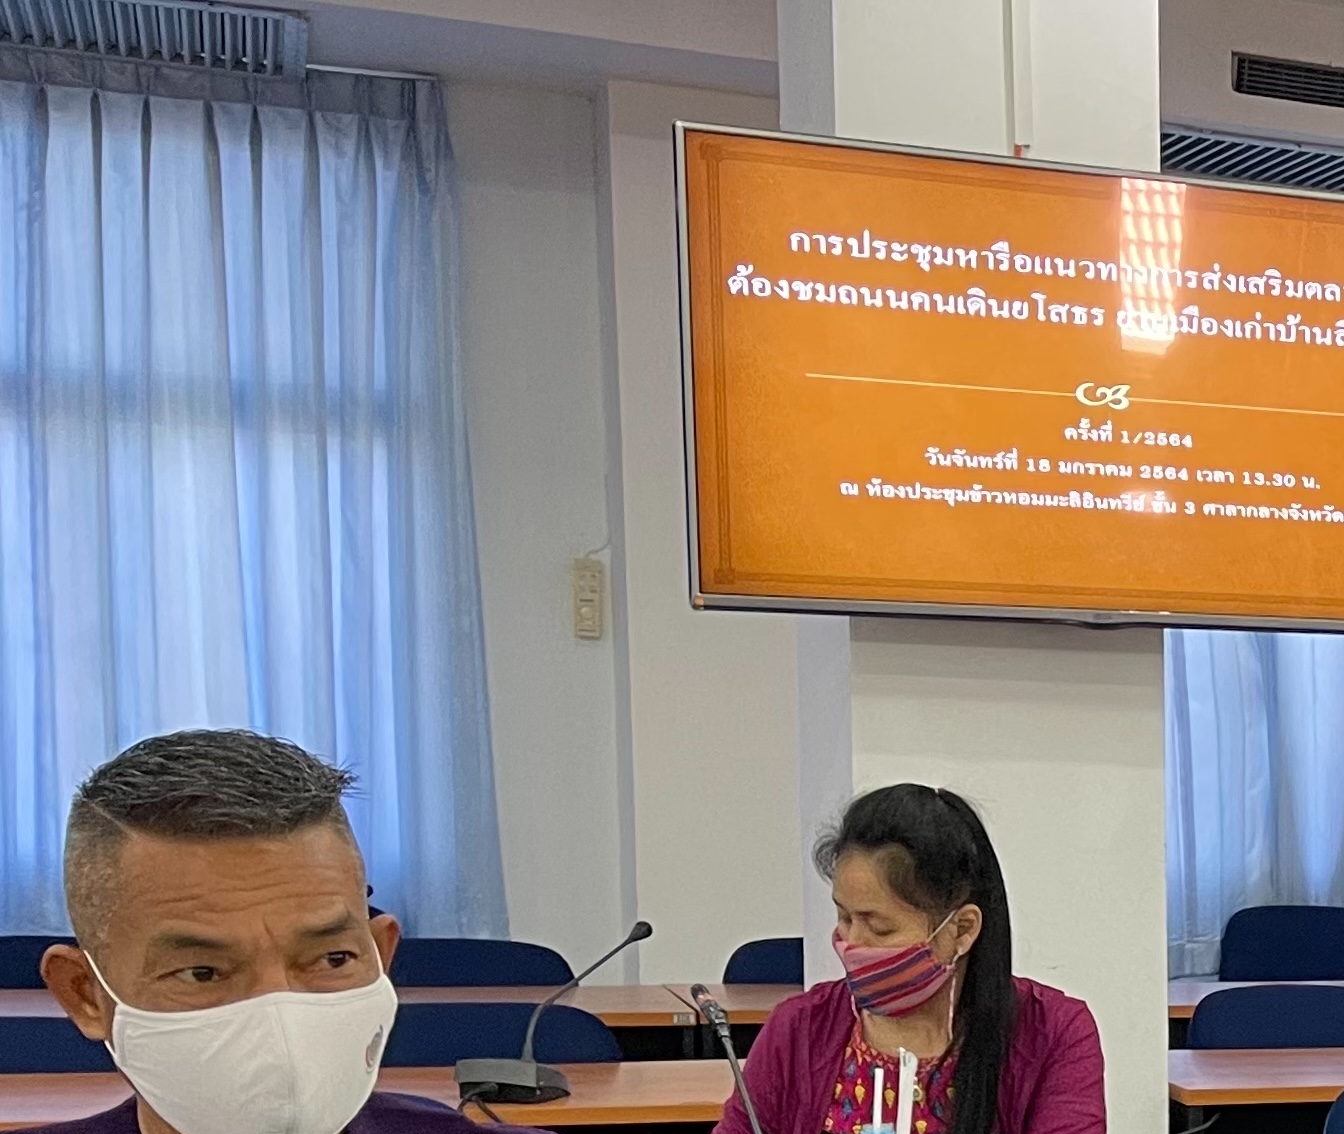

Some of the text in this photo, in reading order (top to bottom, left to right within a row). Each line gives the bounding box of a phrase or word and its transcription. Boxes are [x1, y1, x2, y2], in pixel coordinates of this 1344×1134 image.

[727, 263, 1105, 327] ต้องชมถนนคนเดินยโสธร
[1063, 418, 1193, 448] ครั้งที่ 1/2564
[925, 446, 1321, 490] วันจันทร์ที่ 18 มกราคม 2564 เวลา 13.30 น.
[839, 481, 859, 496] ณ
[1151, 491, 1177, 514] ชั้น
[1184, 501, 1196, 515] 3
